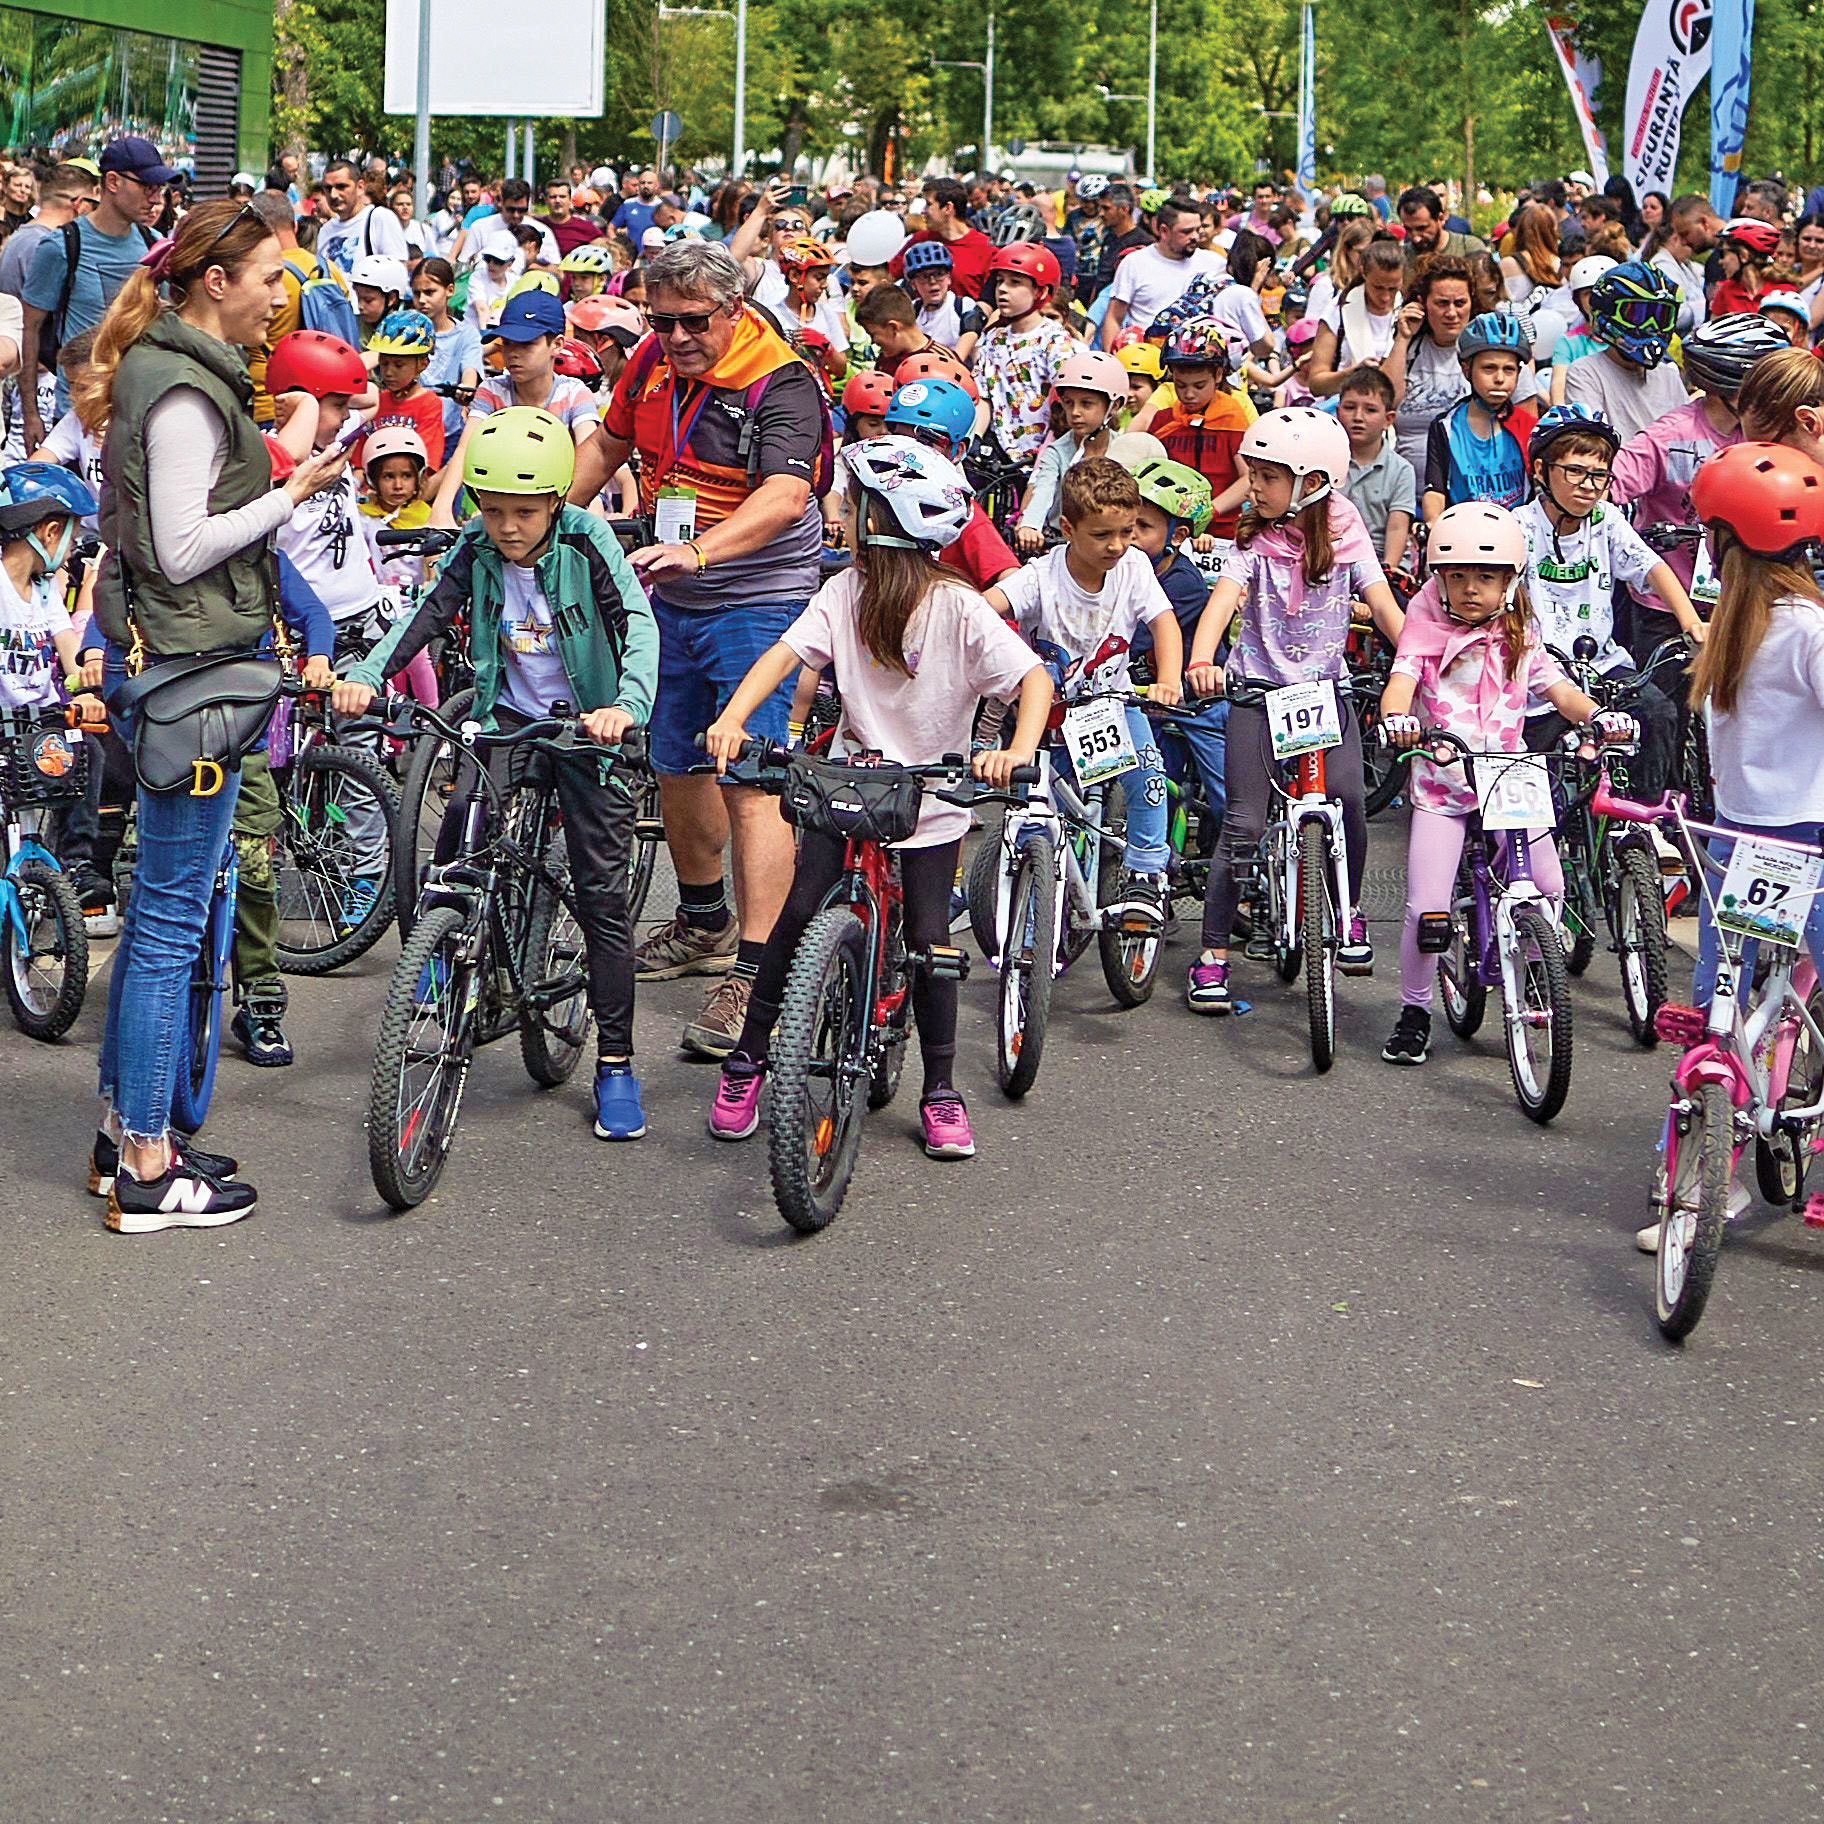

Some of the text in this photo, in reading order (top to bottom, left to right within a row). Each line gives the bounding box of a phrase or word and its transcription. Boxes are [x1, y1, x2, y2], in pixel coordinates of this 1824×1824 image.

[1280, 705, 1325, 734] 197
[1078, 724, 1122, 759] 553
[1747, 877, 1791, 910] 67
